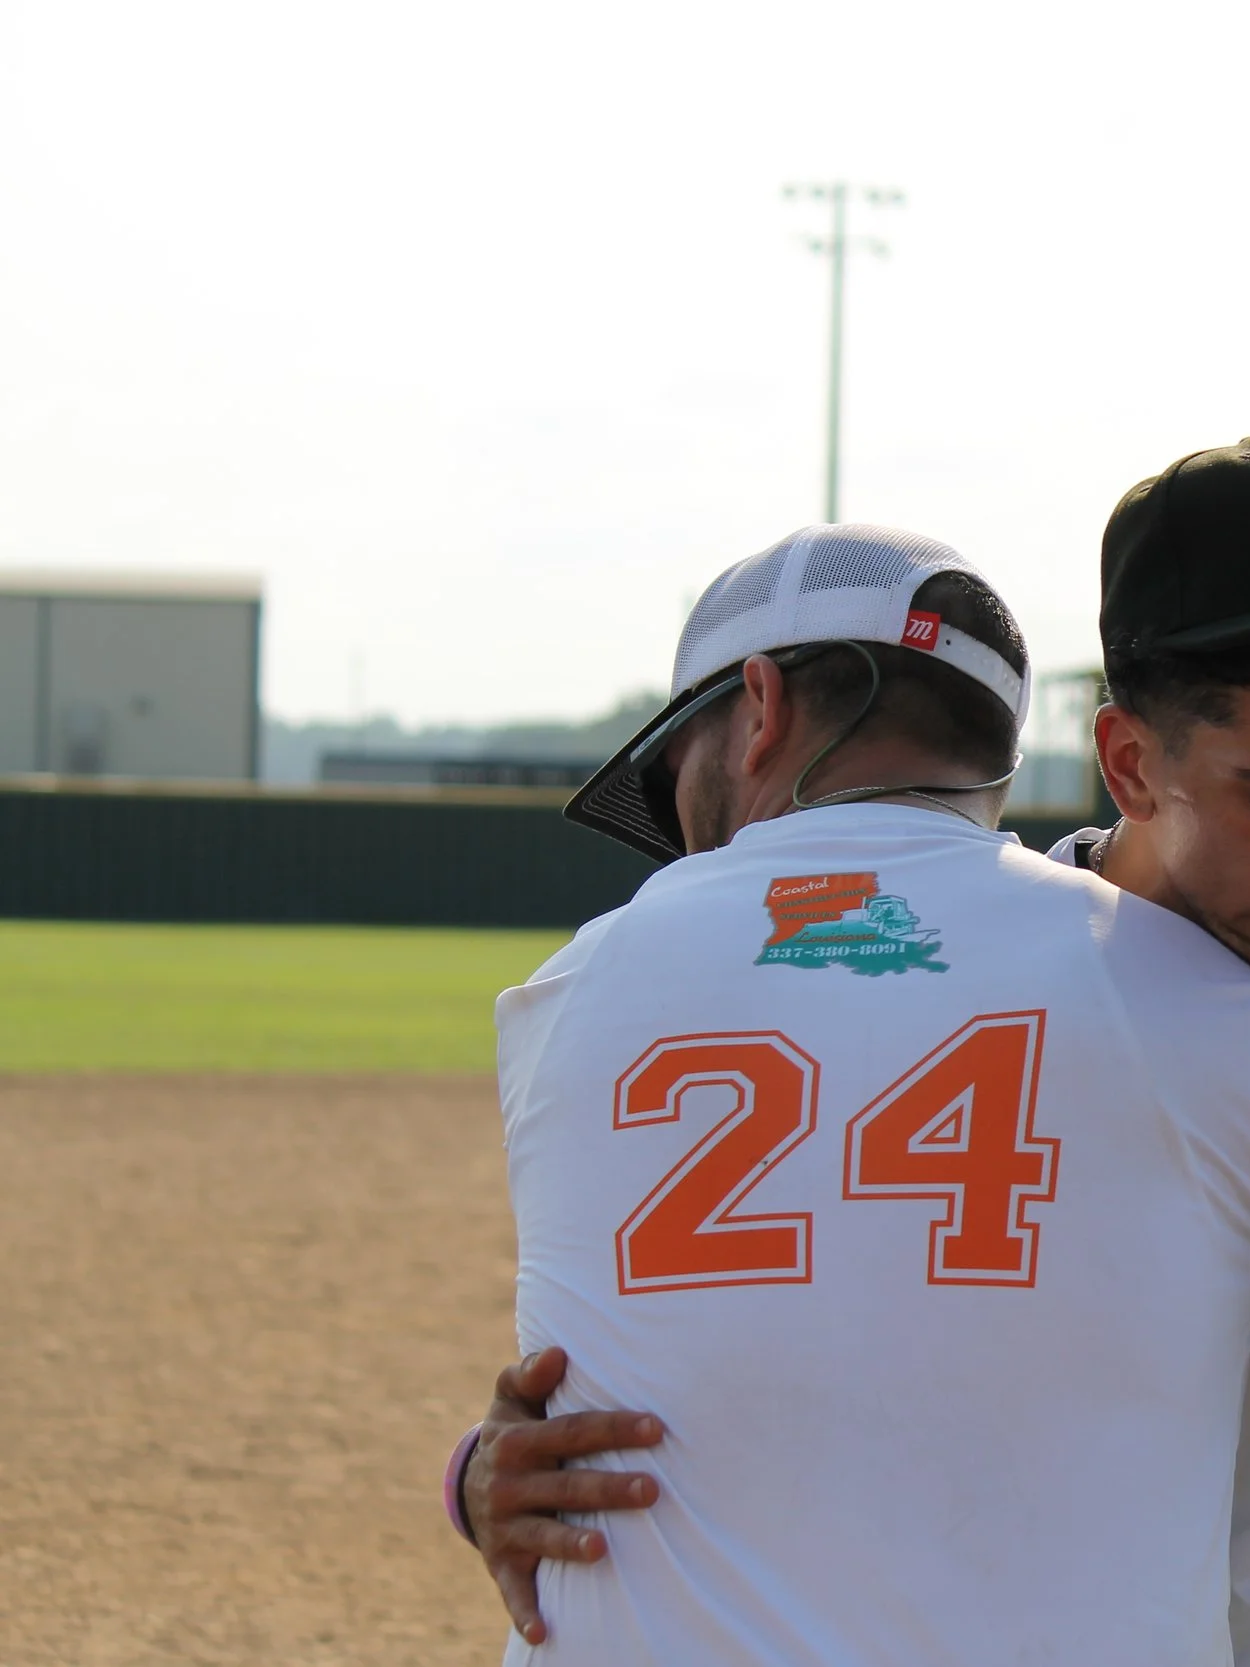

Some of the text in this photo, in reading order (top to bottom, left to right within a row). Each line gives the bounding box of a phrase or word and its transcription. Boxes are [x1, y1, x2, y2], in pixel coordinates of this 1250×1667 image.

[770, 876, 830, 898] Coastal
[767, 943, 906, 959] 337-380-8091
[612, 1008, 1062, 1296] 24
